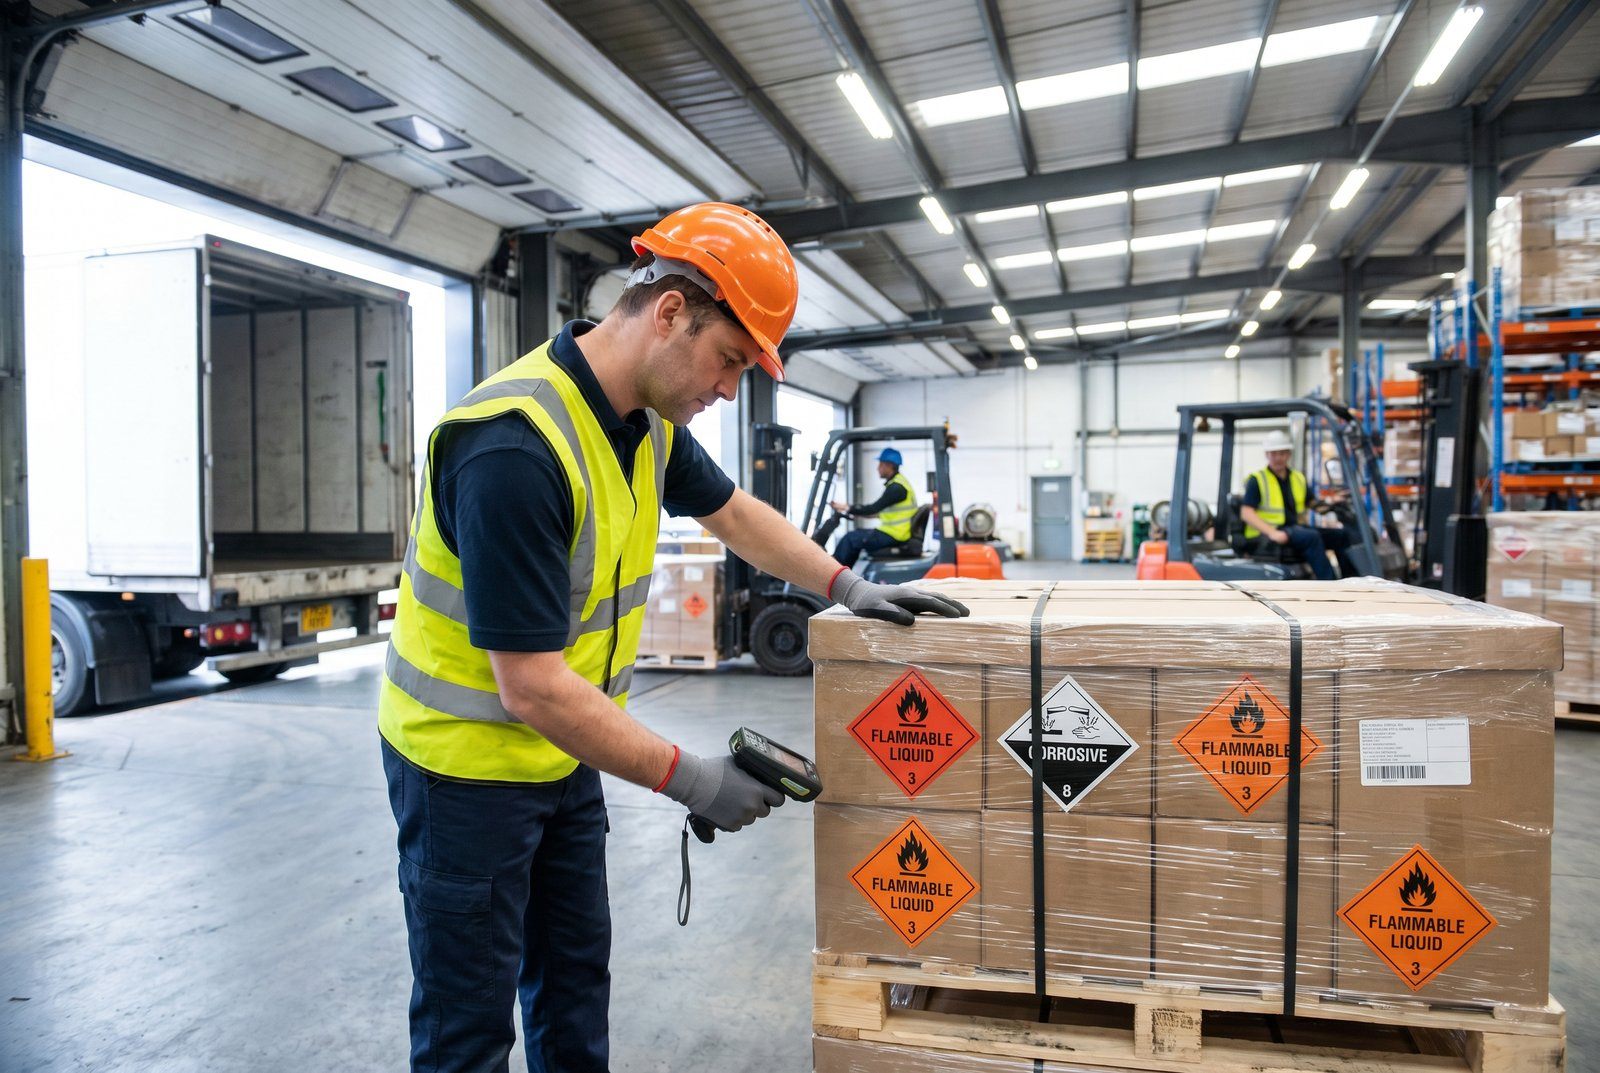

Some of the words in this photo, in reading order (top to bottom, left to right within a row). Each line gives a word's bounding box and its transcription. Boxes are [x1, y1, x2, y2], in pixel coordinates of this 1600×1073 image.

[871, 729, 953, 747] FLAMMABLE
[890, 747, 934, 763] LIQUID
[1201, 741, 1290, 758] FLAMMABLE
[1222, 760, 1272, 776] LIQUID
[908, 772, 916, 785] 3
[1062, 784, 1072, 798] 8
[1242, 786, 1251, 800] 3
[872, 877, 953, 897] FLAMMABLE
[890, 896, 934, 912] LIQUID
[908, 921, 916, 934] 3
[1369, 914, 1465, 934] FLAMMABLE
[1391, 934, 1443, 951] LIQUID
[1411, 962, 1420, 976] 3
